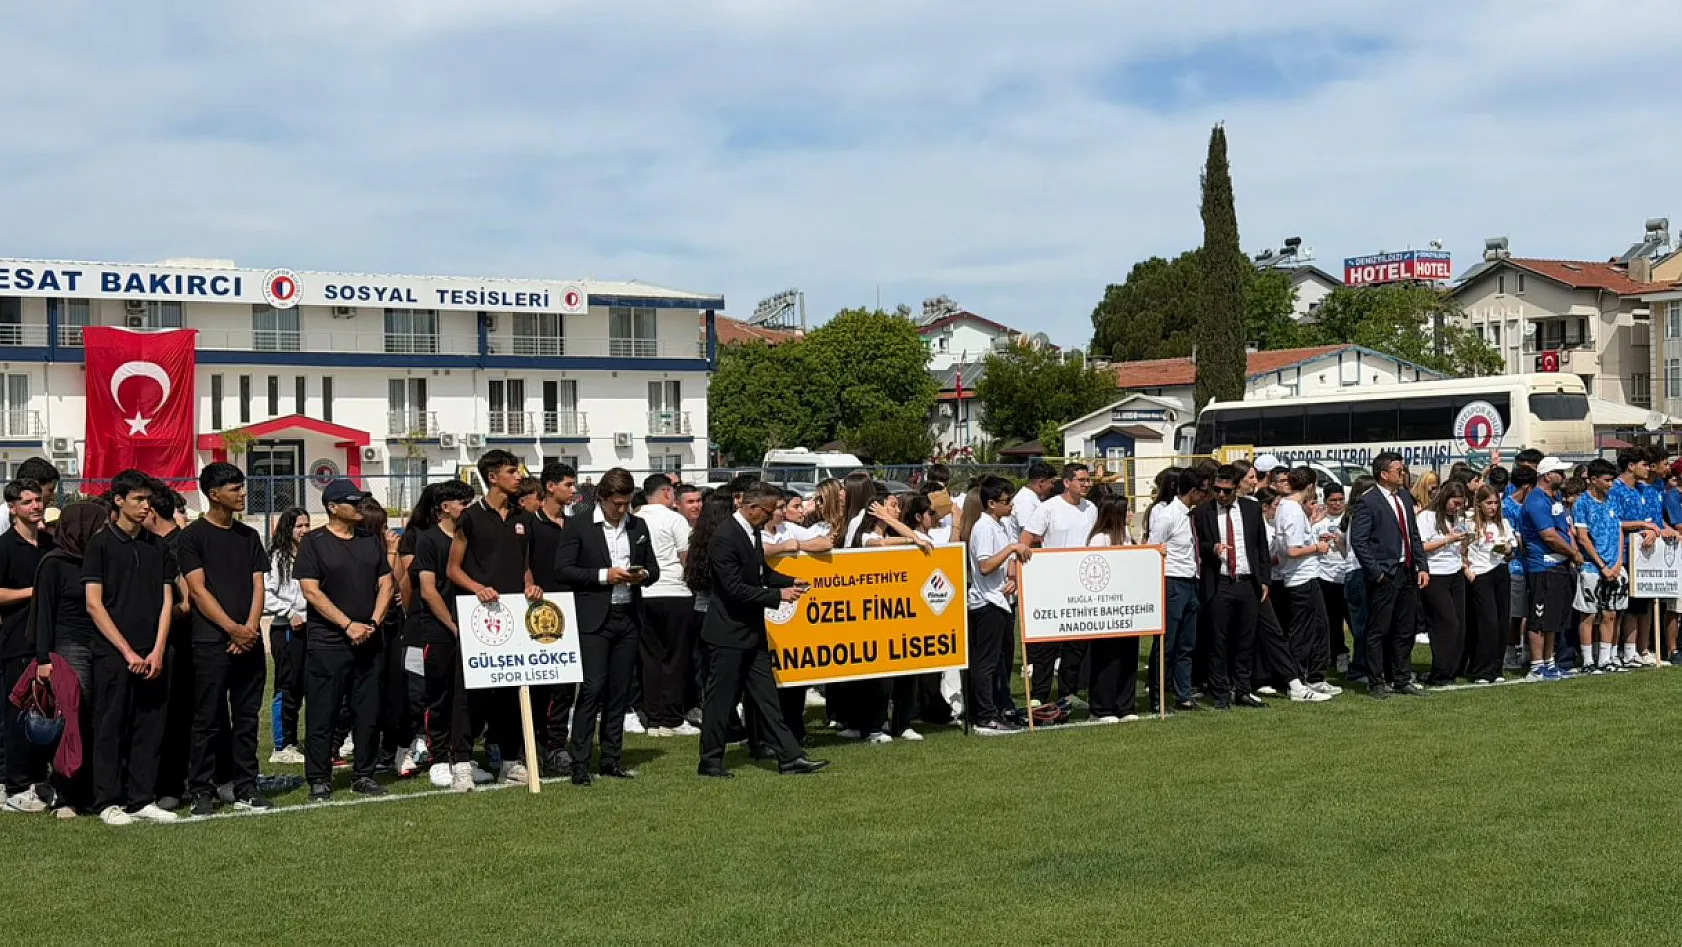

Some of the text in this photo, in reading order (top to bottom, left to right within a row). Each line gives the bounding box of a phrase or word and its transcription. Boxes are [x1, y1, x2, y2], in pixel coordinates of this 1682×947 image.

[1350, 261, 1411, 284] HOTEL
[1417, 261, 1450, 277] HOTEL
[100, 271, 242, 297] BAKIRCI
[324, 284, 418, 303] SOSYAL
[436, 286, 549, 308] TESİSLERİ
[813, 570, 908, 589] MUĞLA-FETHİYE
[806, 594, 917, 625] ÖZEL FİNAL
[1033, 601, 1155, 620] ÖZEL FETHİYE BAHÇEŞEHİR
[1059, 617, 1133, 633] ANADOLU LİSESİ
[889, 629, 957, 661] LİSESİ
[468, 649, 577, 669] GÜLŞEN GÖKÇE
[490, 667, 559, 683] SPOR LİSESİ
